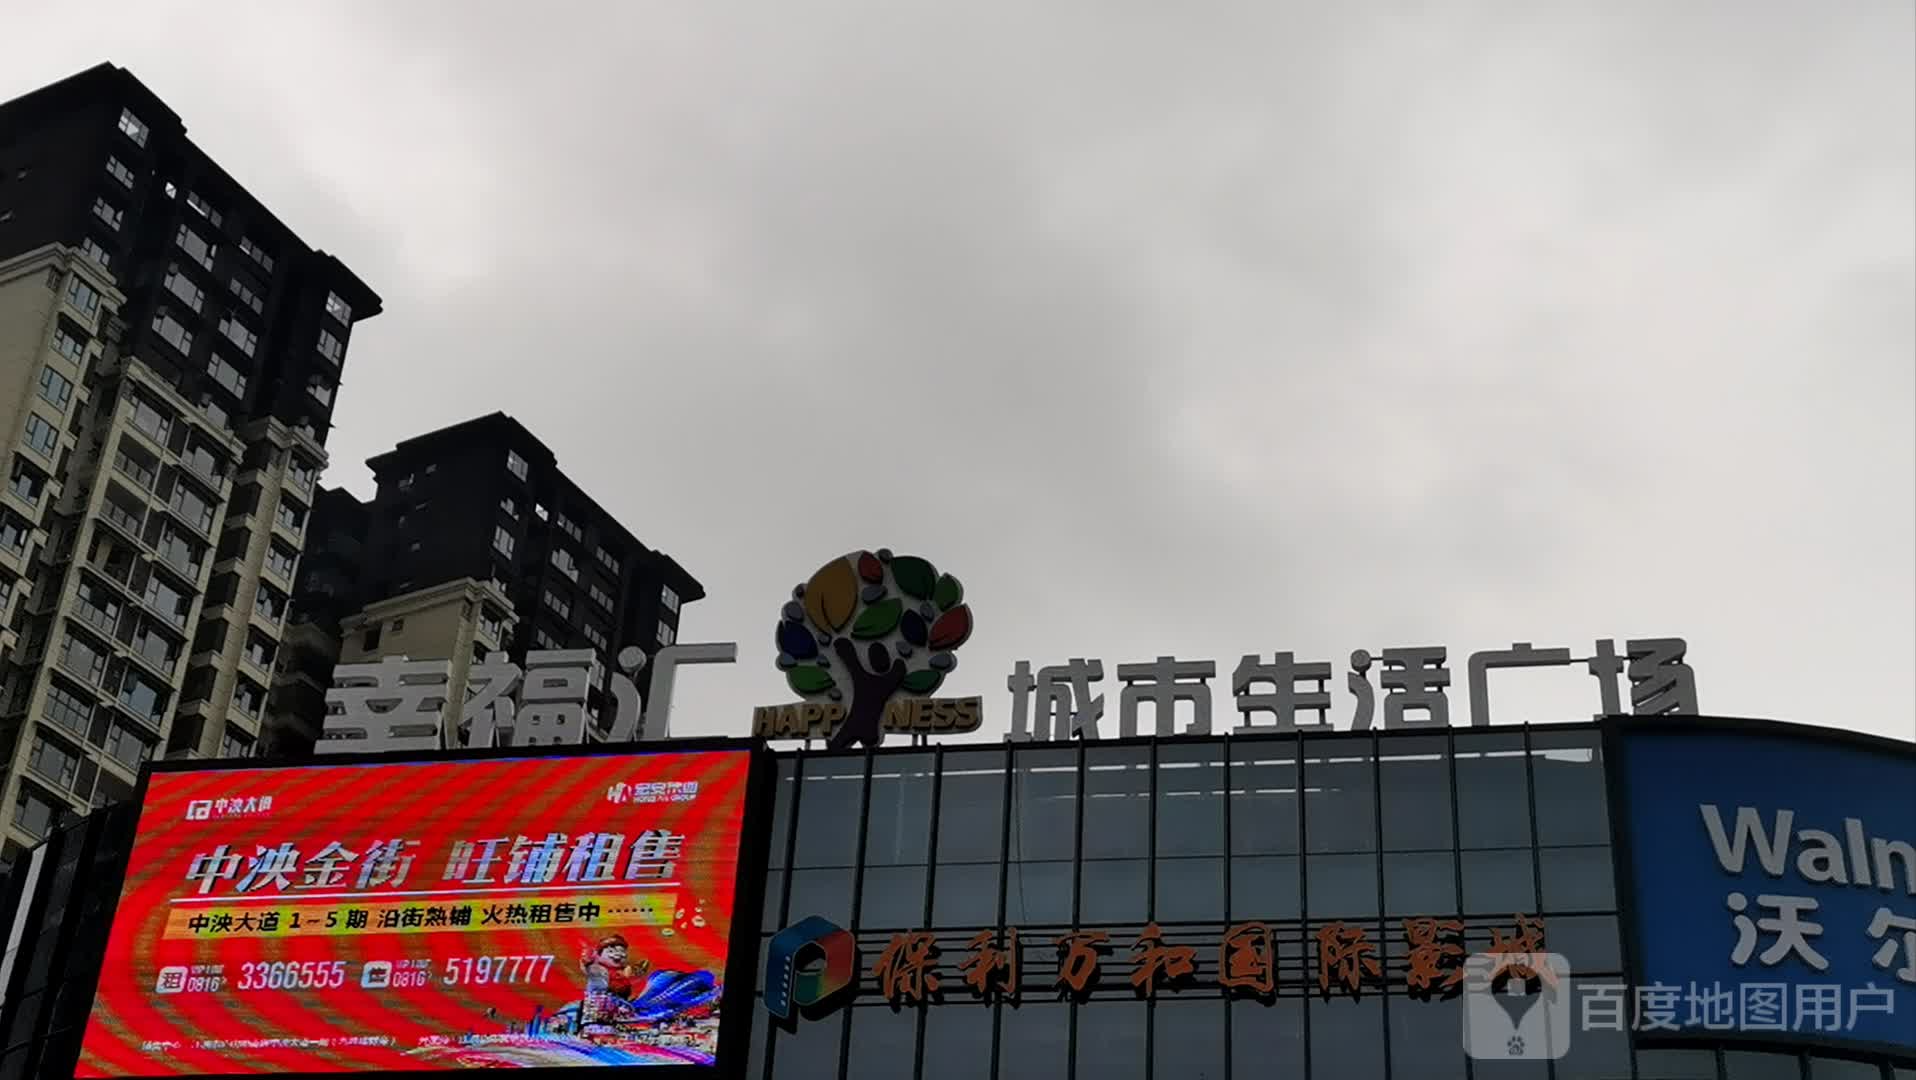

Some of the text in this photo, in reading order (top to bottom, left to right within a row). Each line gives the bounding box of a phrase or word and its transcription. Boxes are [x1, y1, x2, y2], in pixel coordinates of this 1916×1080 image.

[314, 642, 738, 754] 幸福汇
[1004, 638, 1699, 742] 城市生活广场
[185, 829, 686, 894] 中泱金街 旺铺租售
[188, 911, 280, 933] 中泱大道
[237, 961, 346, 990] 3366555
[443, 955, 555, 984] 5197777
